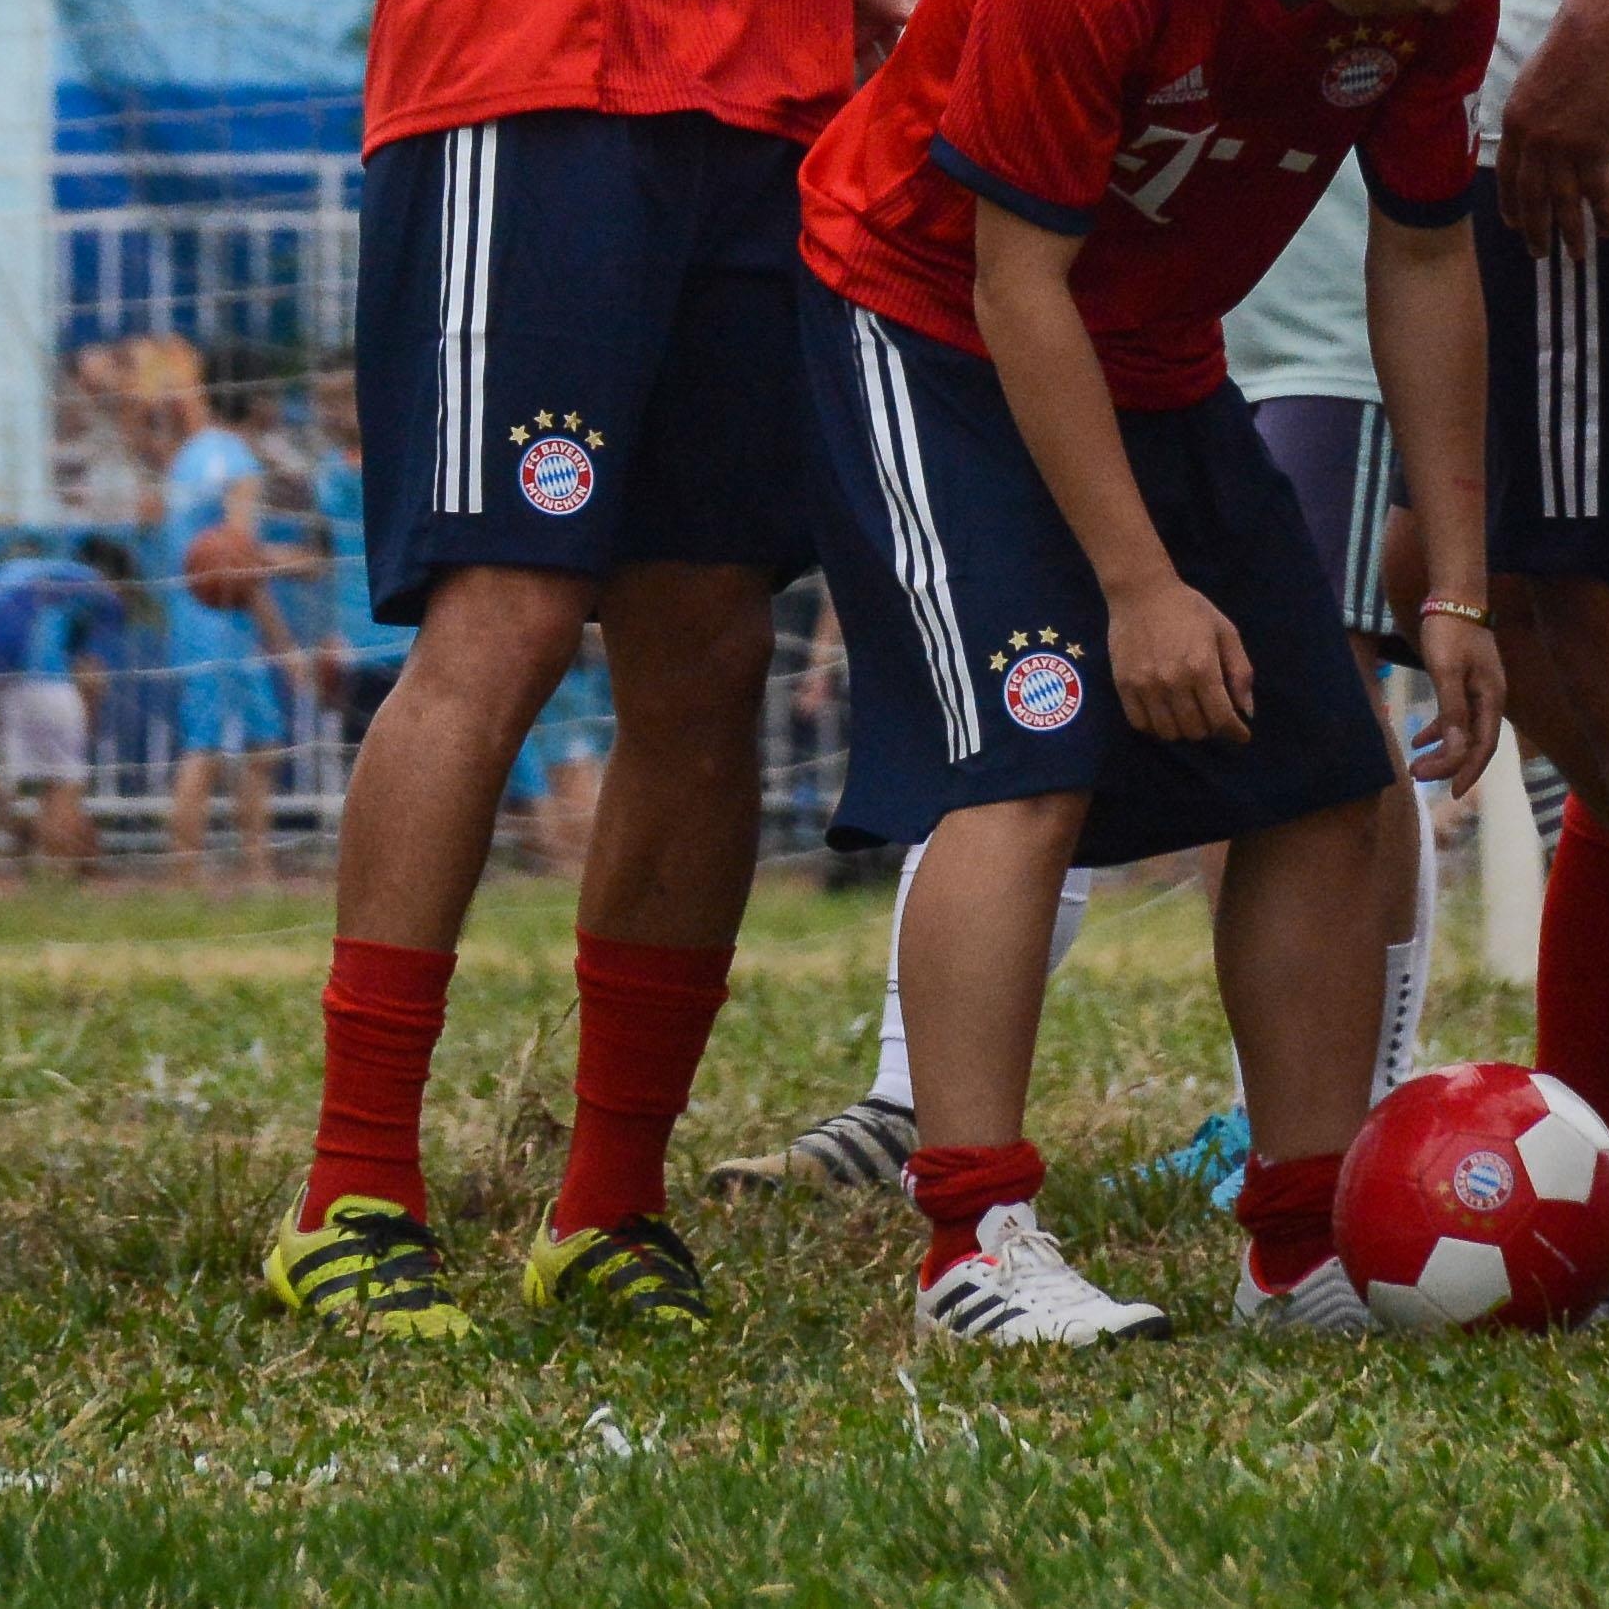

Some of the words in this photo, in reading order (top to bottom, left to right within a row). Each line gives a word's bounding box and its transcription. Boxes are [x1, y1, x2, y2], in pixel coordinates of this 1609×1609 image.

[525, 452, 541, 470] FC
[540, 442, 589, 473] BAYERN
[1021, 656, 1075, 684] BAYERN
